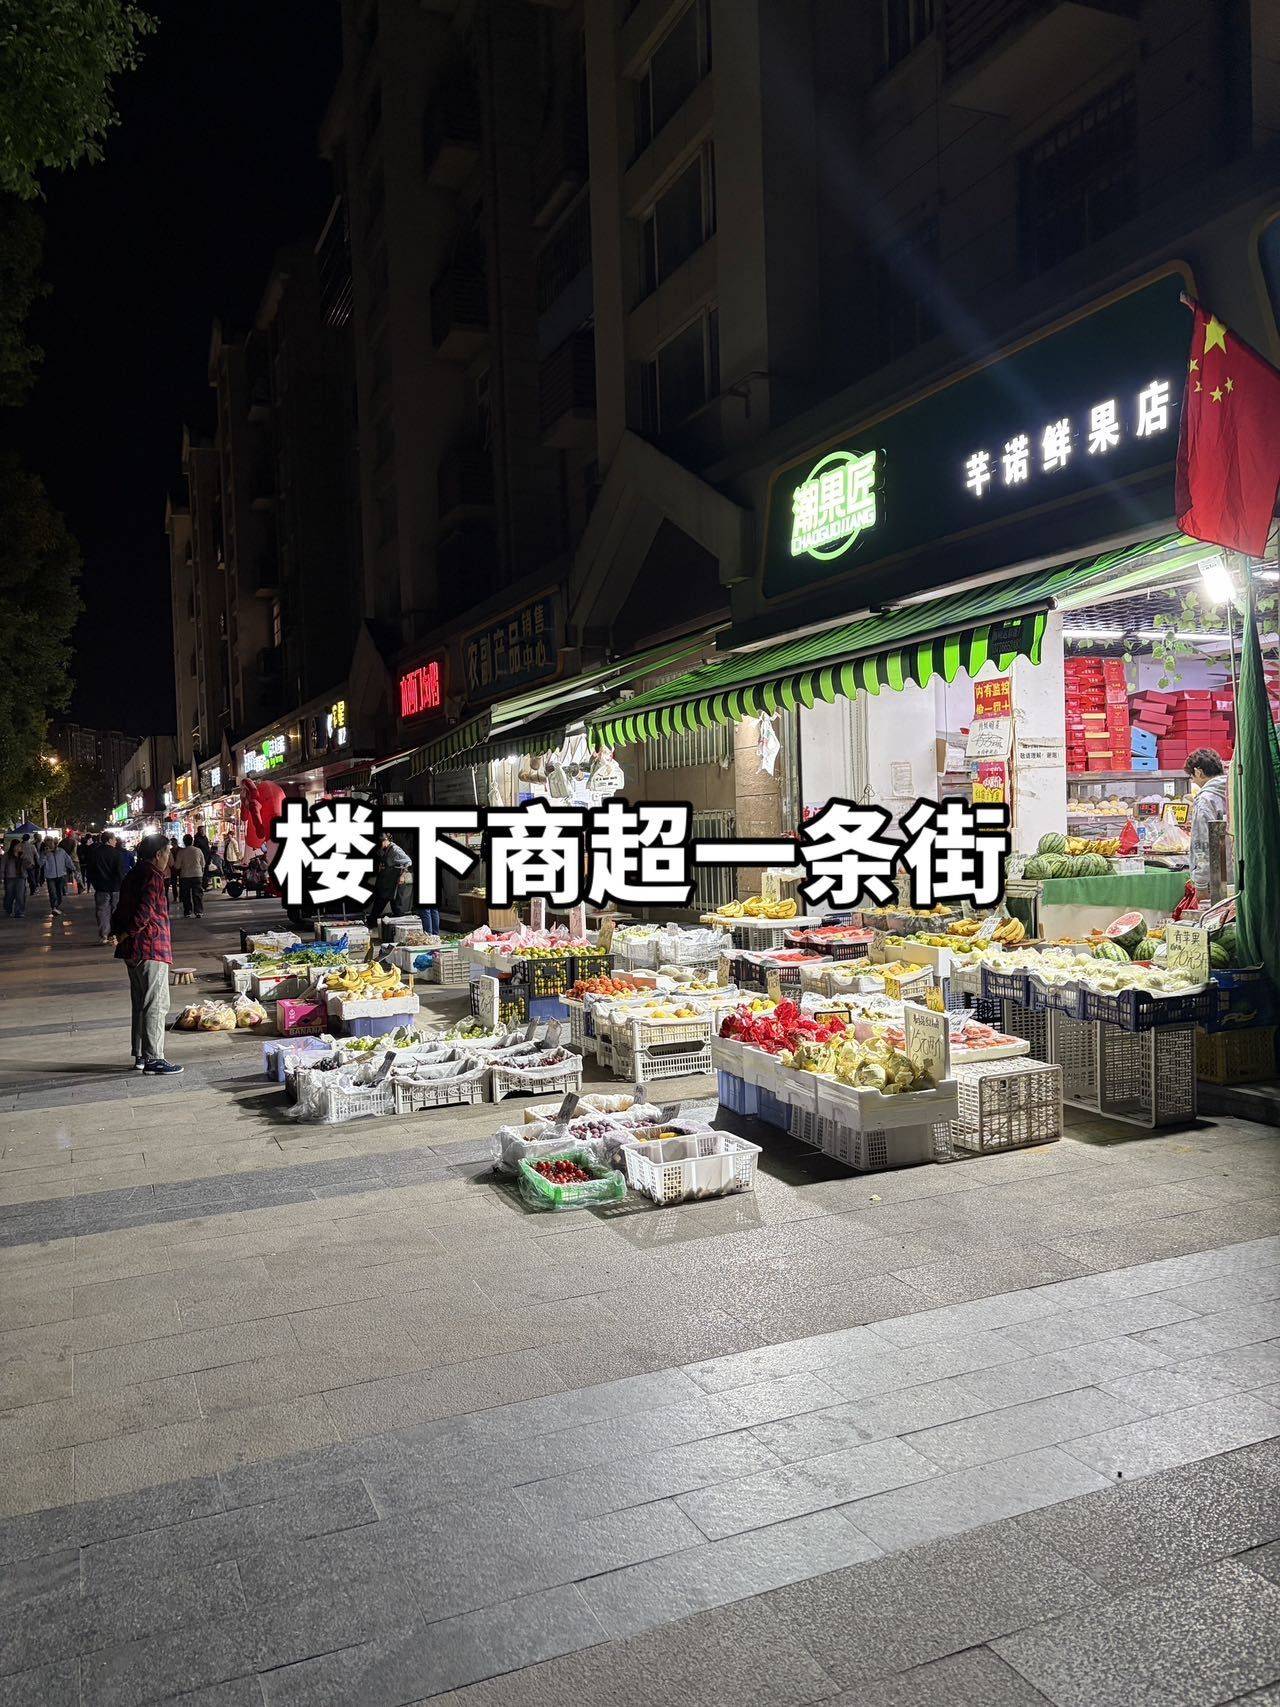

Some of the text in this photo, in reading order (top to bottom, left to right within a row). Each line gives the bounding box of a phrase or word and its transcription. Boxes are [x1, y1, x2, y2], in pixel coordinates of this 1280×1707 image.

[793, 451, 876, 536] 潮果匠
[975, 681, 1009, 699] 内有监控
[1175, 930, 1200, 946] 青苹果
